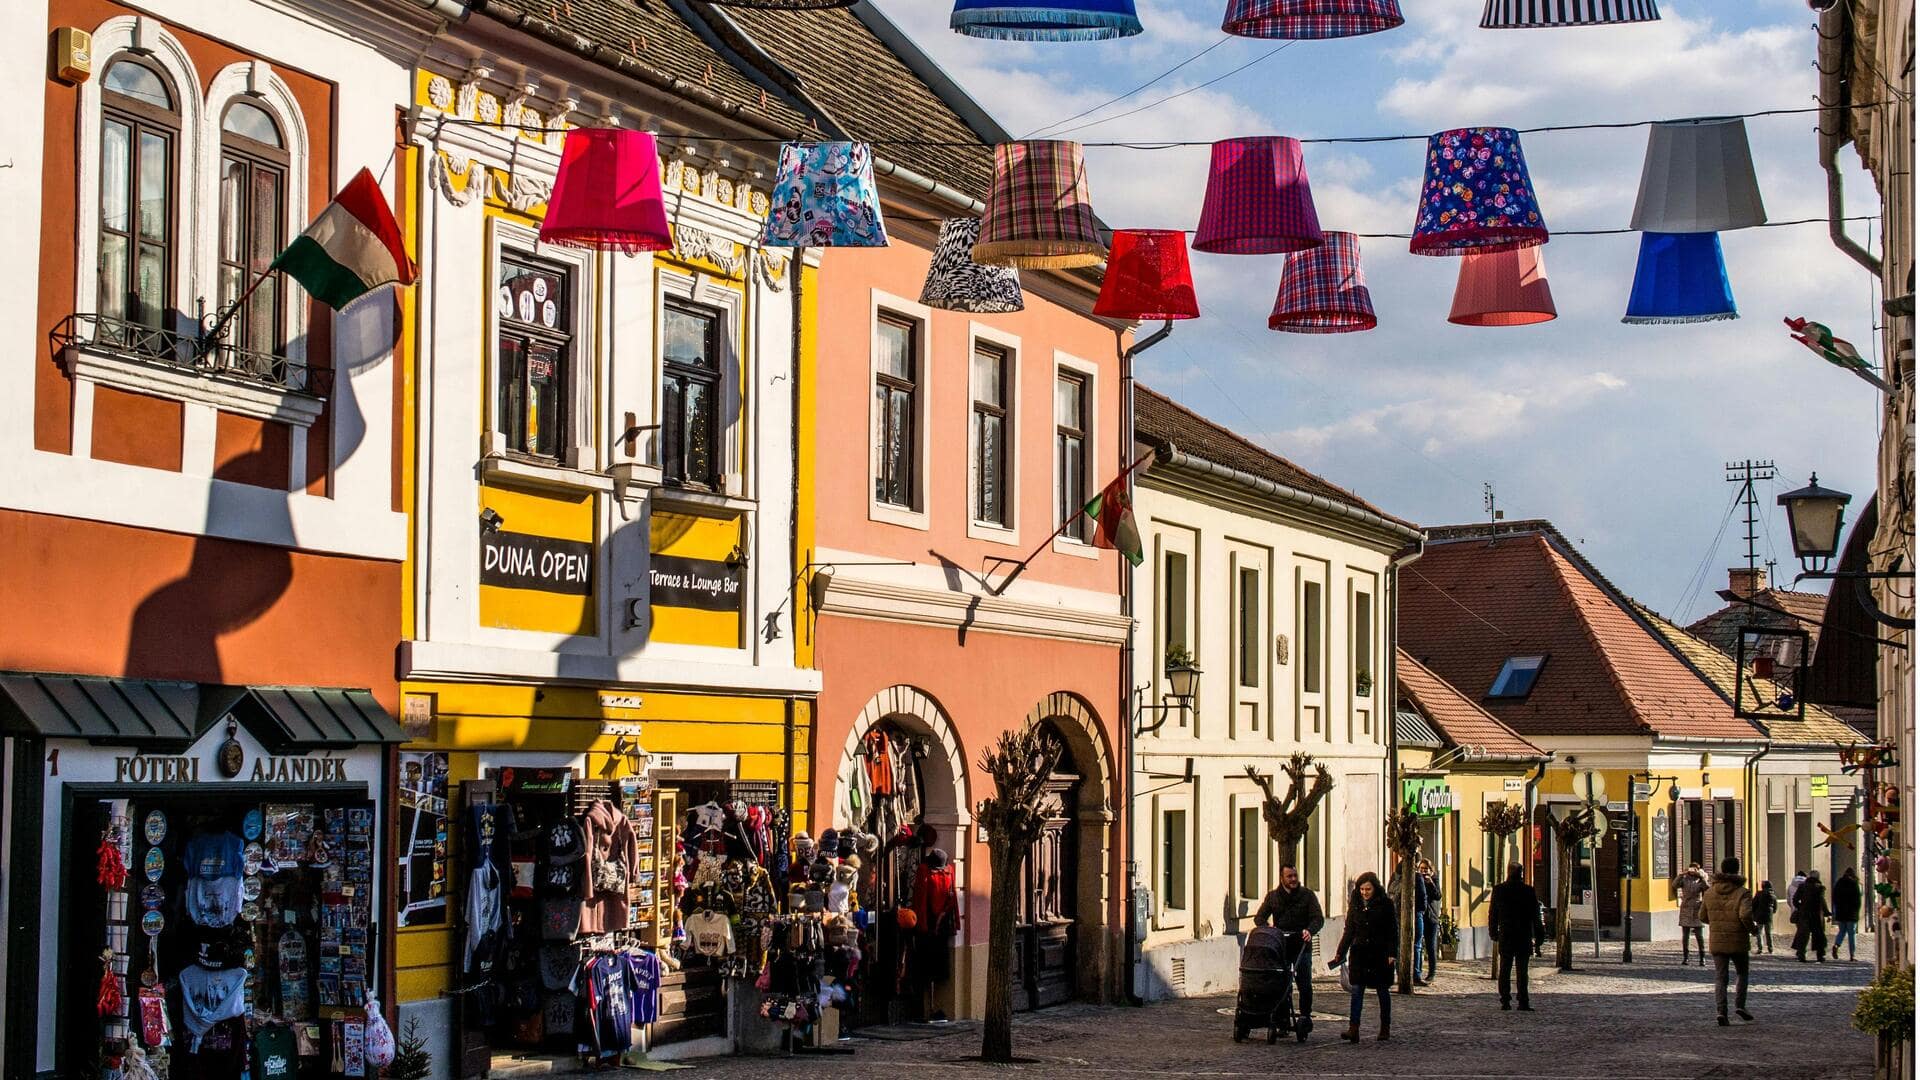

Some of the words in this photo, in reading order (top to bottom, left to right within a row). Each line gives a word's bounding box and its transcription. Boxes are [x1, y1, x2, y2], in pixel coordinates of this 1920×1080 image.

[485, 545, 535, 576] DUNA
[541, 550, 588, 583] OPEN
[649, 570, 681, 588] Terrace
[682, 575, 689, 589] &
[692, 574, 722, 597] Lounge
[724, 577, 739, 593] Bar
[46, 749, 59, 777] 1
